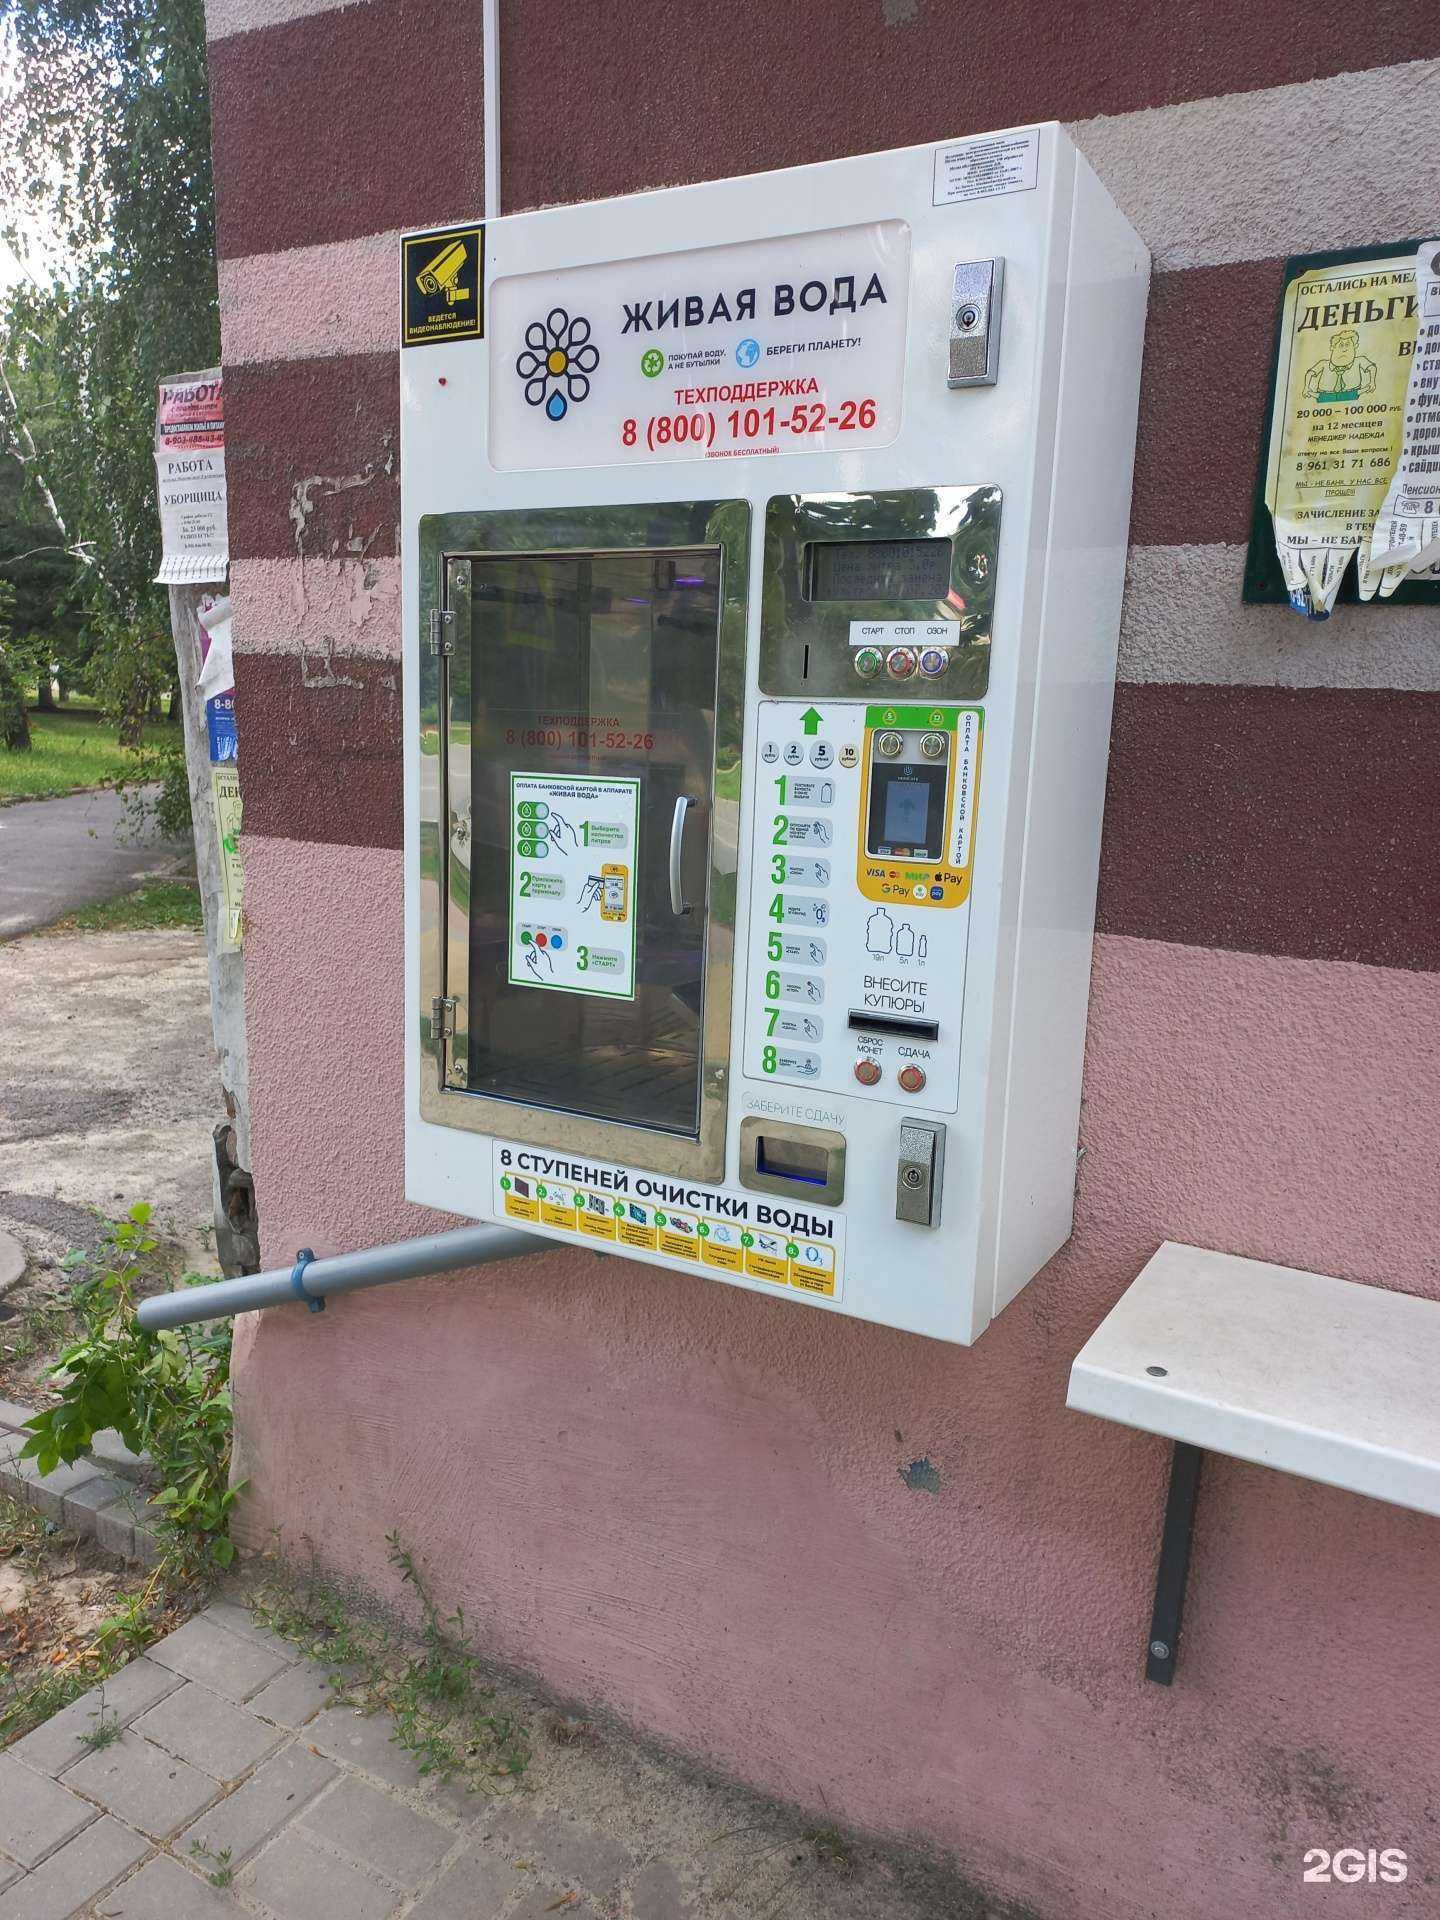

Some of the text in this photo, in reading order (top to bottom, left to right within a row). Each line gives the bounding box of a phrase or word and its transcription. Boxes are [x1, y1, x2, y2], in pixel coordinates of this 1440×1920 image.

[1300, 278, 1368, 296] ОСТАЛИСЬ
[1370, 276, 1388, 288] НА
[621, 272, 887, 335] ЖИВАЯ ВОДА
[766, 337, 861, 356] БЕРЕГИ ПЛАНЕТУ!
[667, 349, 727, 363] ПОКУПАЙ ВОДУ,
[675, 362, 685, 370] НЕ
[686, 359, 721, 369] БУТЫЛКИ
[673, 376, 819, 406] ТЕХПОДДЕРЖКА
[1418, 393, 1440, 408] фун
[1296, 409, 1310, 420] 20
[1312, 408, 1333, 418] 000
[1344, 405, 1364, 416] 100
[1366, 404, 1387, 414] 000
[622, 398, 877, 452] 8 (800) 101-52-26
[1311, 420, 1383, 432] на 12 месяцев
[1349, 431, 1385, 441] НАДЕЖДА
[704, 446, 780, 458] (ЗВОНОК БЕСПЛАТНЫЙ)
[168, 458, 213, 474] РАБОТА
[1296, 458, 1390, 471] 8 961 31 71 686
[1409, 459, 1440, 474] сайди
[164, 490, 223, 505] УБОРЩИЦА
[1297, 508, 1365, 520] ЗАЧИСЛЕНИЕ
[1424, 500, 1434, 514] 8
[1345, 522, 1352, 531] В
[1286, 536, 1309, 546] МЫ
[1321, 536, 1337, 545] НЕ
[861, 627, 948, 636] СТАРТ СТОП ОЗОН
[537, 714, 621, 728] ТЕХПОДДЕРЖКА
[505, 729, 654, 751] 8 (800) 101-52-26
[791, 745, 797, 754] 2
[818, 745, 826, 756] 5
[845, 748, 855, 756] 10
[516, 782, 538, 790] ОПЛАТА
[538, 783, 575, 791] БАНКОВСКОЙ
[575, 784, 597, 793] КАРТОЙ
[603, 787, 633, 795] АППАРАТЕ
[774, 774, 787, 806] 1
[953, 714, 973, 865] ОПЛАТА БАНКОВСКОЙ КАРТОЙ
[579, 820, 589, 847] 1
[772, 814, 788, 846] 2
[771, 854, 787, 885] 3
[866, 869, 886, 878] VISA
[519, 871, 532, 898] 2
[944, 872, 963, 887] Pay
[893, 884, 910, 897] Pay
[769, 893, 785, 924] 4
[767, 931, 783, 962] 5
[576, 945, 589, 971] 3
[765, 970, 781, 1000] 6
[864, 975, 928, 997] ВНЕСИТЕ
[864, 993, 925, 1013] КУПЮРЫ
[764, 1007, 780, 1037] 7
[857, 1035, 884, 1047] СБРОС
[856, 1045, 884, 1056] МОНЕТ
[897, 1046, 930, 1061] СДАЧА
[762, 1045, 777, 1074] 8
[747, 1099, 845, 1126] ЗАБЕРИТЕ СДАЧУ
[501, 1149, 833, 1239] 8 СТУПЕНЕЙ ОЧИСТКИ ВОДЫ
